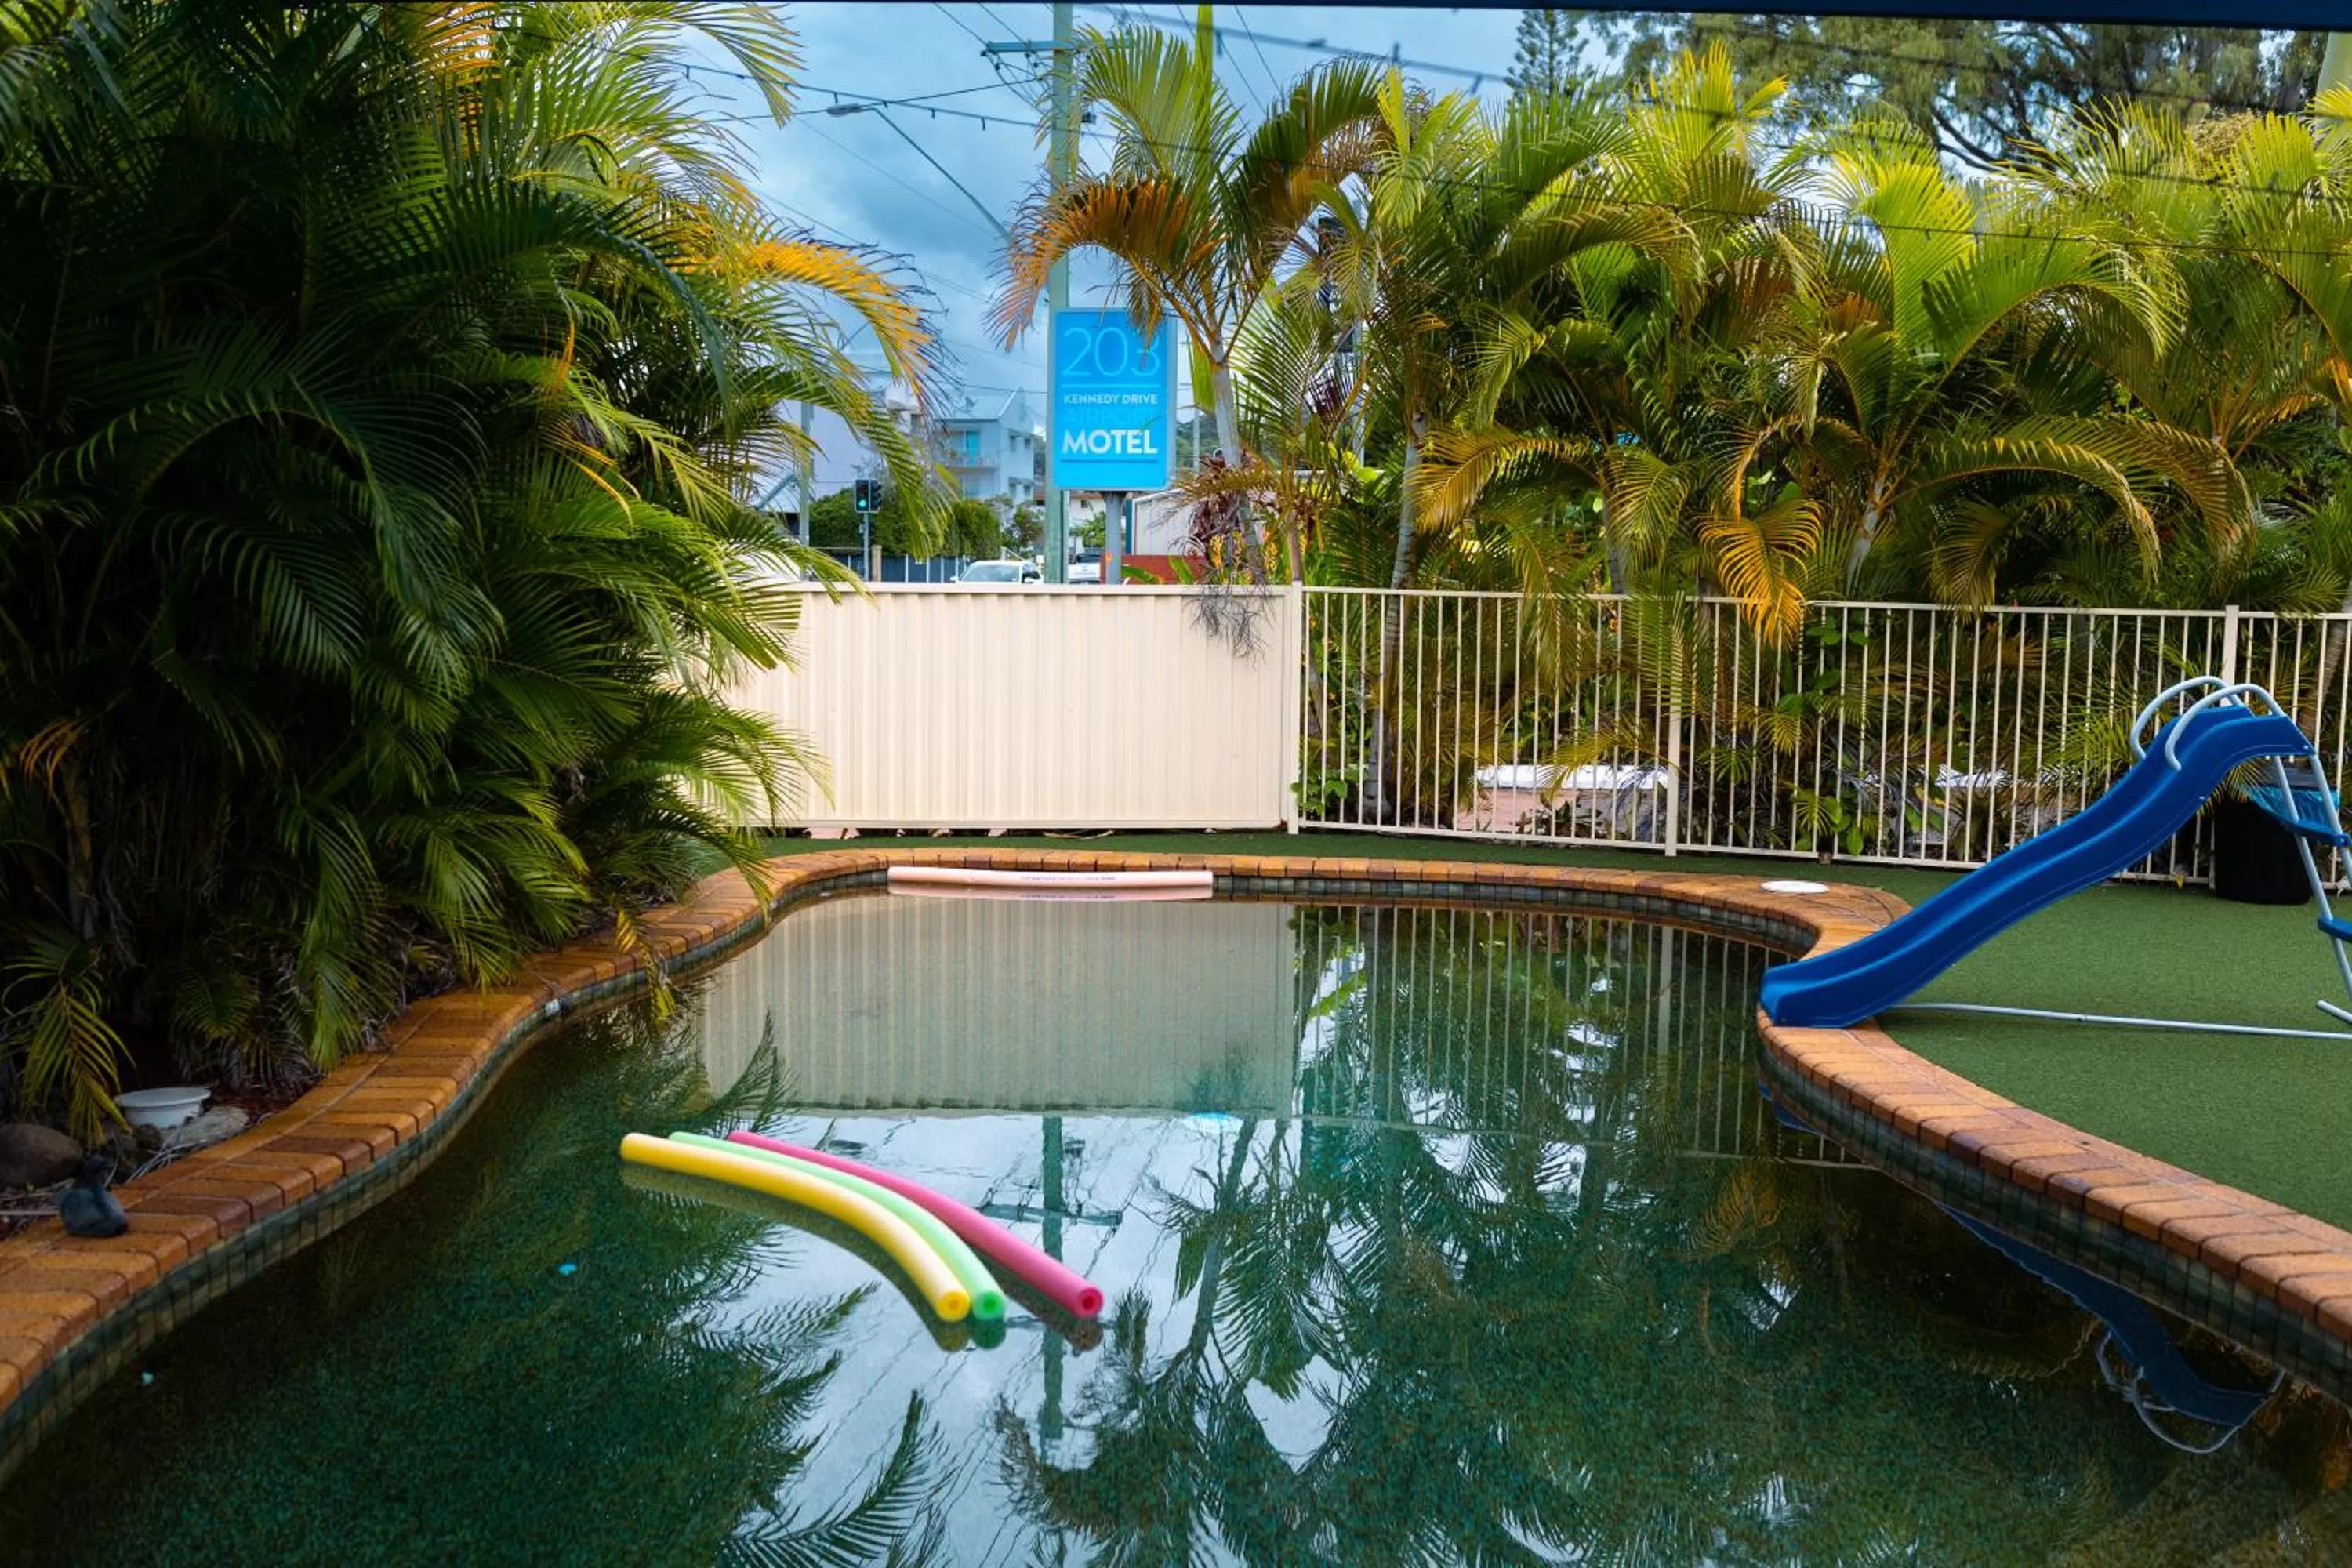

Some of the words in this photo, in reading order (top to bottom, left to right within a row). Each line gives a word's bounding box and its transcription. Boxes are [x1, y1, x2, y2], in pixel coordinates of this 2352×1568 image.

[1062, 327, 1160, 376] 203
[1064, 394, 1120, 404] KENNEDY
[1122, 394, 1157, 404] DRIVE
[1062, 429, 1159, 454] MOTEL
